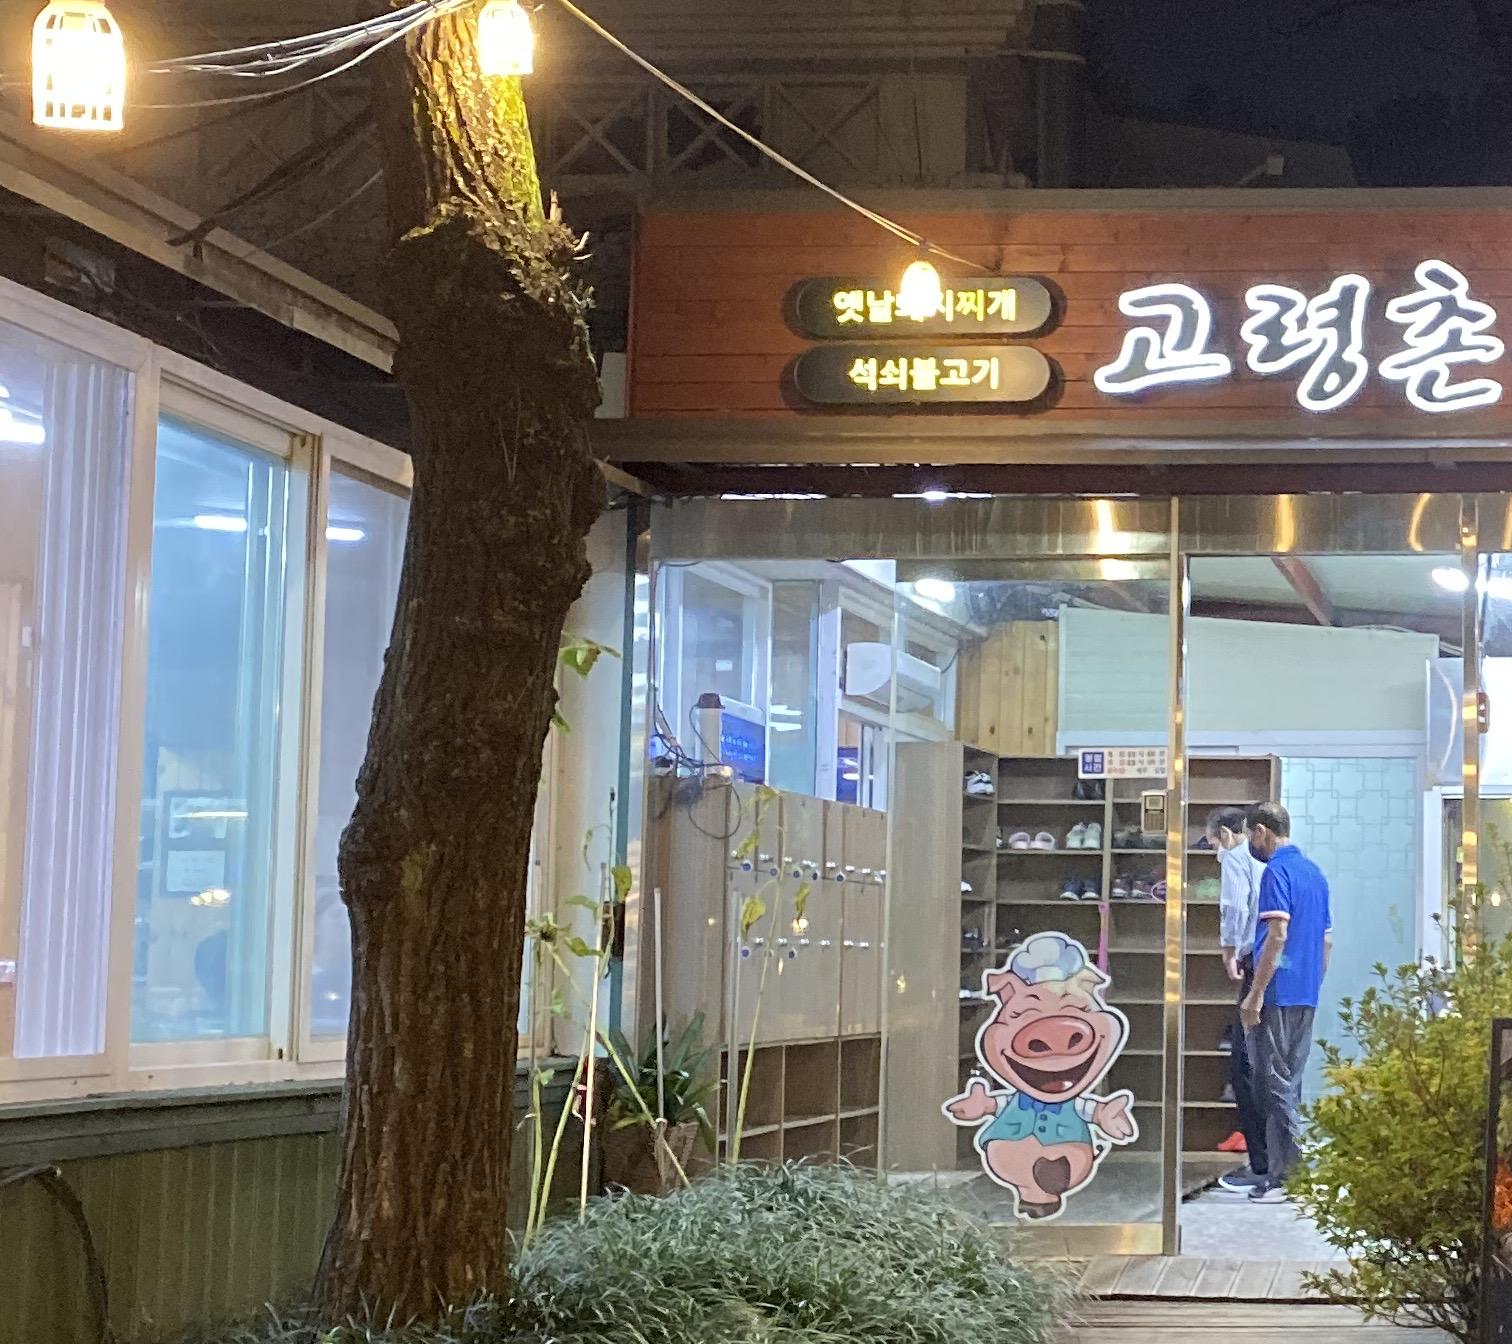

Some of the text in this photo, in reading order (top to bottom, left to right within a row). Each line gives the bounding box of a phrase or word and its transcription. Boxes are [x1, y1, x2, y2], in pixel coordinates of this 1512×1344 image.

[832, 288, 1017, 324] 옛날지찌개
[1093, 258, 1506, 413] 고령촌
[848, 356, 1000, 392] 석쇠불고기
